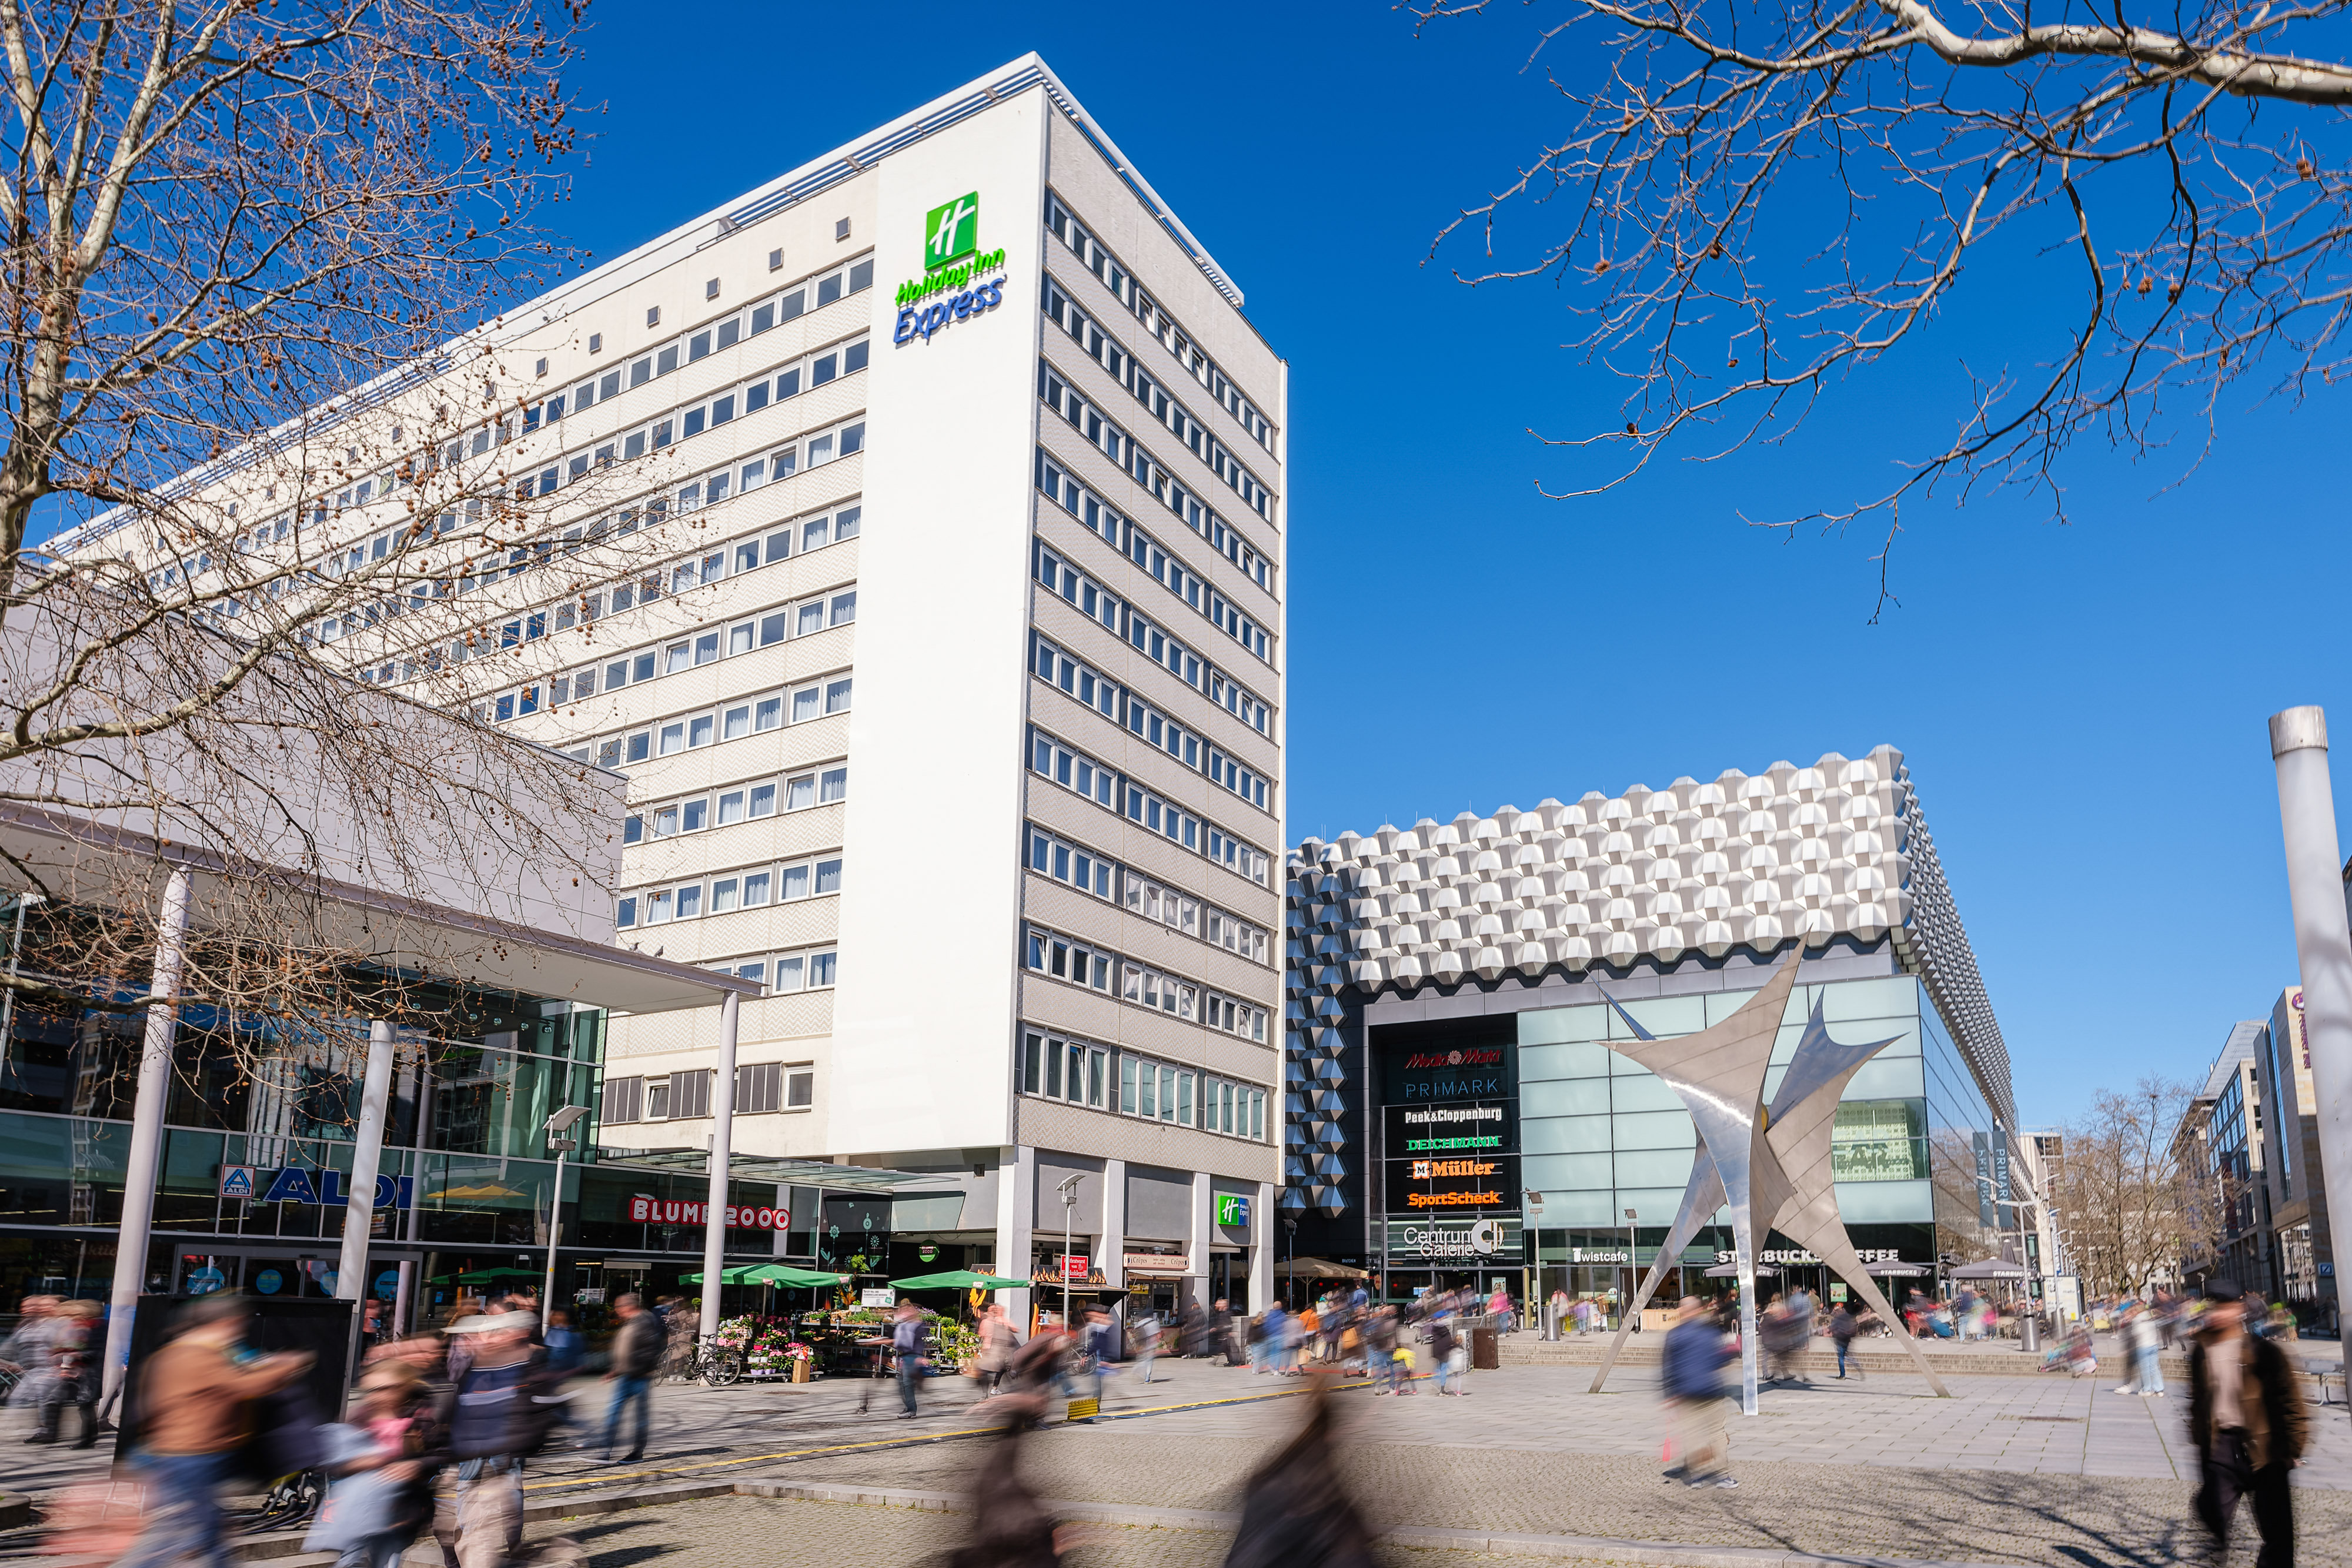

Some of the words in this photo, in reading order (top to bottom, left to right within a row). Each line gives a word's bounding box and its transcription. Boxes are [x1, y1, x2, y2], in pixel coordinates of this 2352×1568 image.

[895, 260, 971, 307] Holiday
[973, 248, 1005, 274] Inn
[893, 277, 1004, 343] Express
[1406, 1078, 1498, 1098] PRIMARK
[1405, 1107, 1502, 1124] Peek&Cloppenburg
[1408, 1136, 1499, 1151] DEICHMANN
[1431, 1160, 1495, 1177] Müller
[263, 1166, 413, 1209] ALDI
[1409, 1191, 1500, 1208] SportScheck
[726, 1207, 789, 1228] 2000
[1404, 1226, 1473, 1245] Centrum
[1421, 1242, 1475, 1257] Galerie
[1572, 1248, 1628, 1262] Twistcafe
[1718, 1249, 1822, 1263] STBUCK
[1855, 1249, 1899, 1262] FFEE
